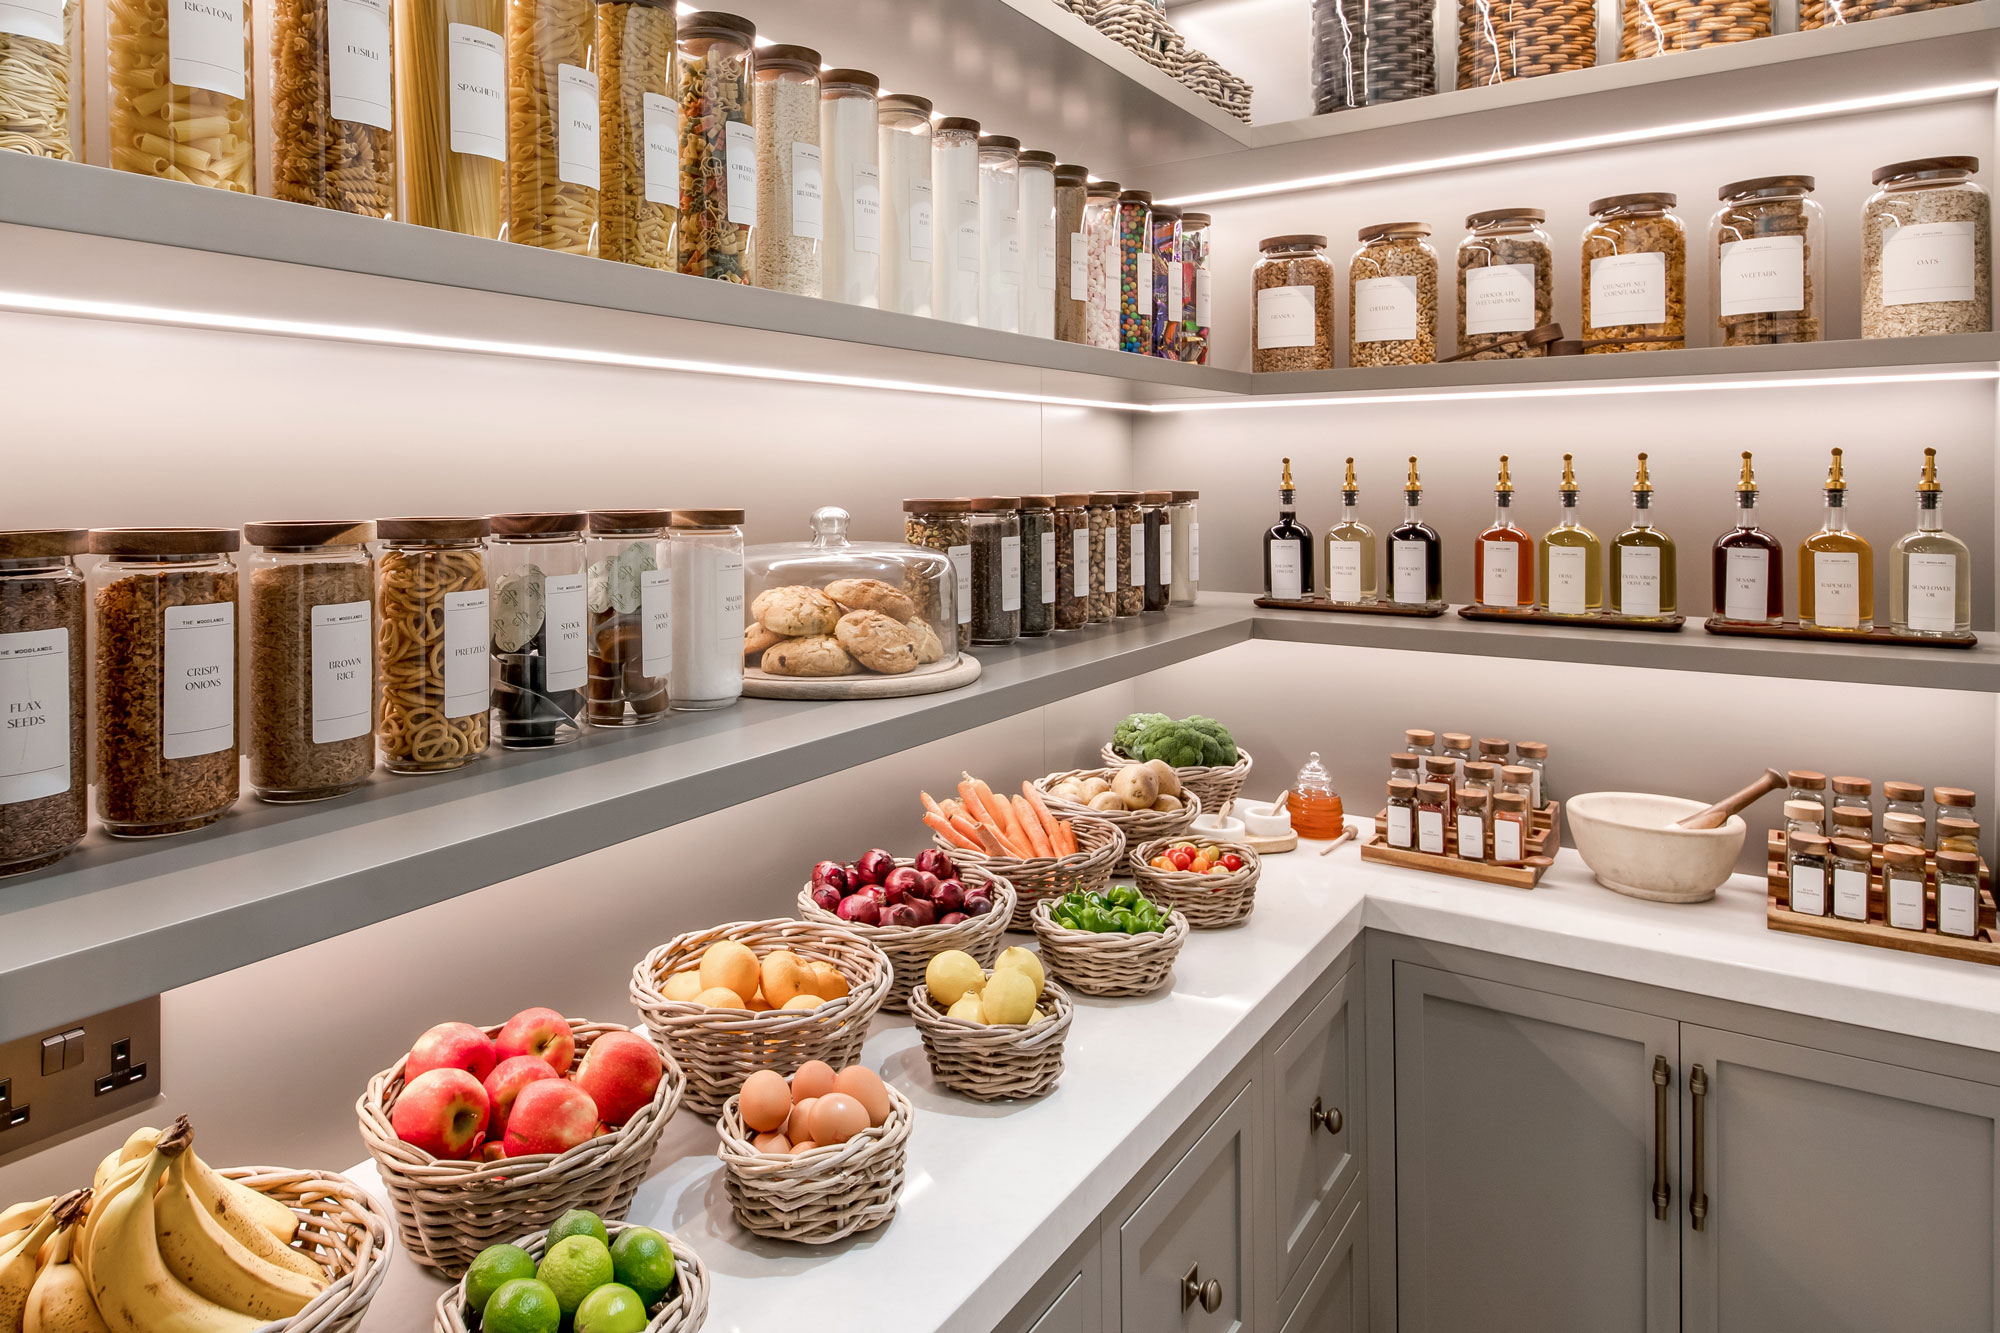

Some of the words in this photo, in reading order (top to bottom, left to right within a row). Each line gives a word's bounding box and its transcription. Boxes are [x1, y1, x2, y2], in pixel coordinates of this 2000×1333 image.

[184, 1, 233, 22] RIGATONI
[347, 45, 379, 61] FUSILLI
[456, 83, 500, 100] SPAGHETTI
[1917, 258, 1939, 267] OATS
[1911, 584, 1952, 593] SUNFLOWER
[197, 617, 225, 625] WOODLANDS
[560, 620, 582, 631] STOCK
[563, 632, 580, 641] POTS
[15, 645, 53, 655] WOODLANDS
[455, 645, 487, 657] PRETZELS
[329, 657, 362, 670] BROWN
[186, 665, 221, 678] CRISPY
[336, 671, 356, 682] RICE
[185, 679, 222, 692] ONIONS
[10, 700, 43, 714] FLAX
[7, 715, 46, 729] SEEDS
